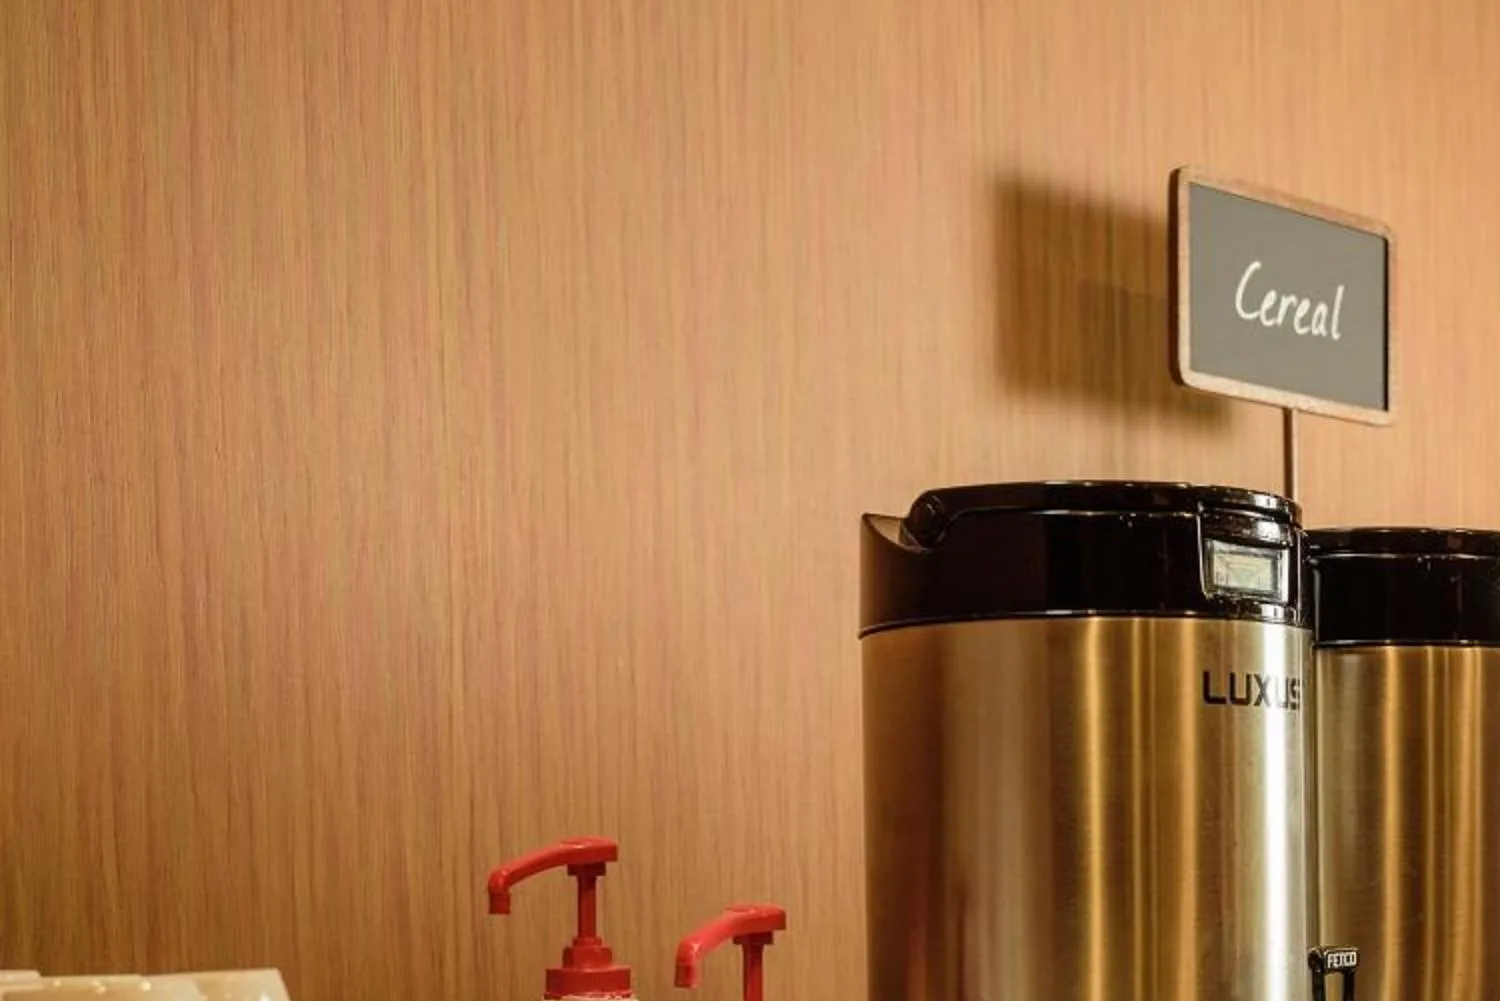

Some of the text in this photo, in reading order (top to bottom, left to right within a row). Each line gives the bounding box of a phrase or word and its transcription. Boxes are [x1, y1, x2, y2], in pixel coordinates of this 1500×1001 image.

[1235, 260, 1345, 340] Cereal
[1202, 671, 1304, 710] LUXUS
[1327, 951, 1357, 968] FETCO
